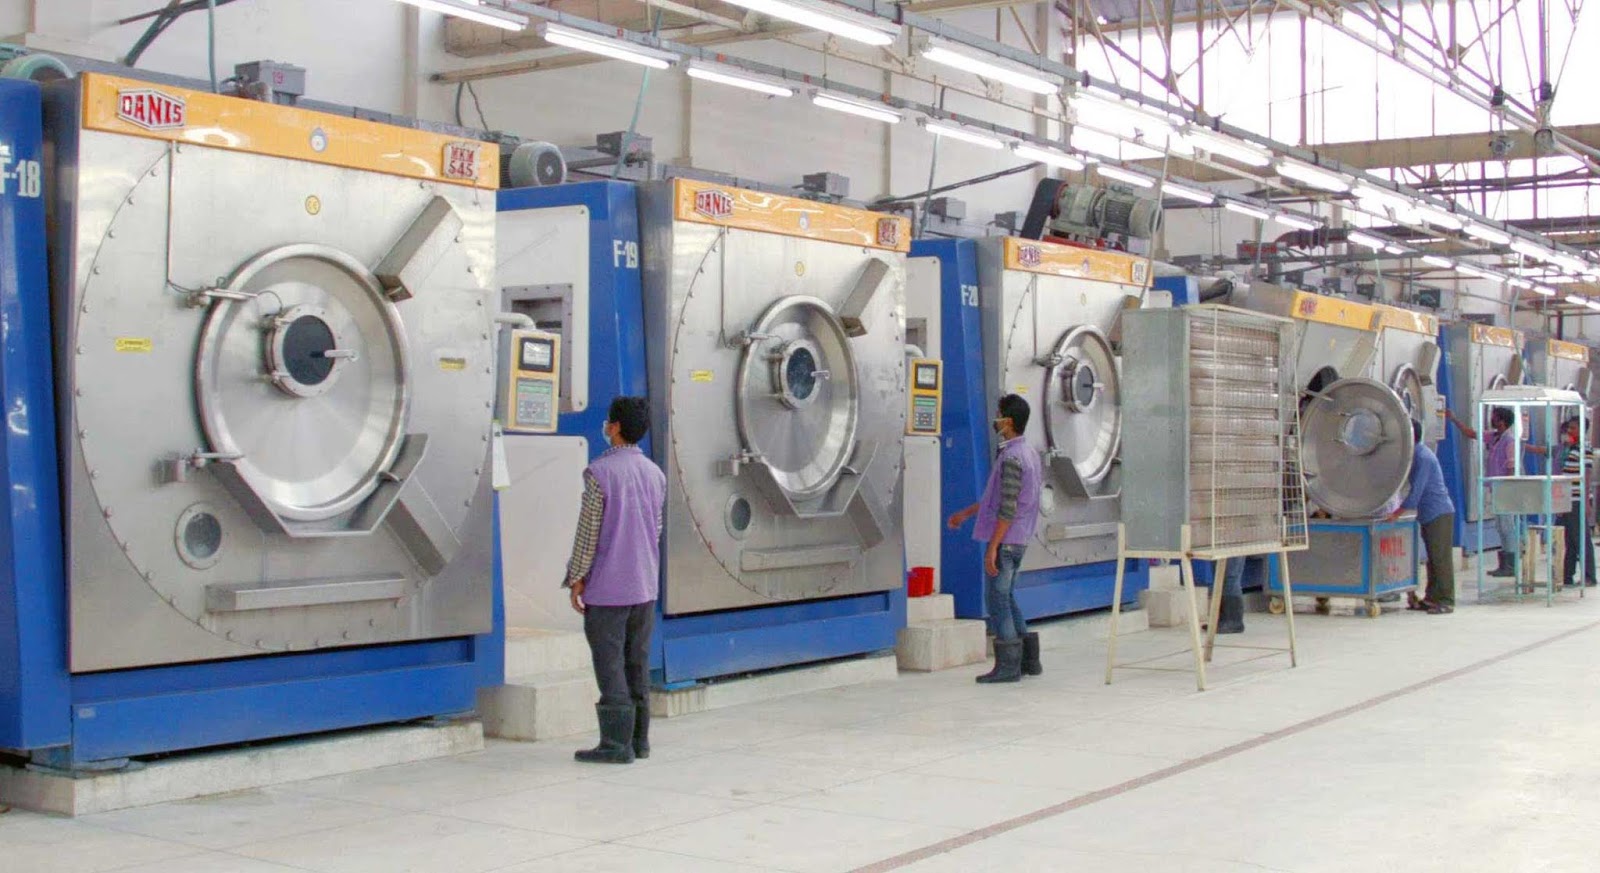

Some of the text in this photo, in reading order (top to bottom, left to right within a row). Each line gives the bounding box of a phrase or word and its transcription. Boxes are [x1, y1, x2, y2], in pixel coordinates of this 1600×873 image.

[122, 94, 182, 125] DANIS
[0, 156, 41, 198] F-18
[698, 193, 731, 215] DANIS
[613, 239, 638, 269] F-19
